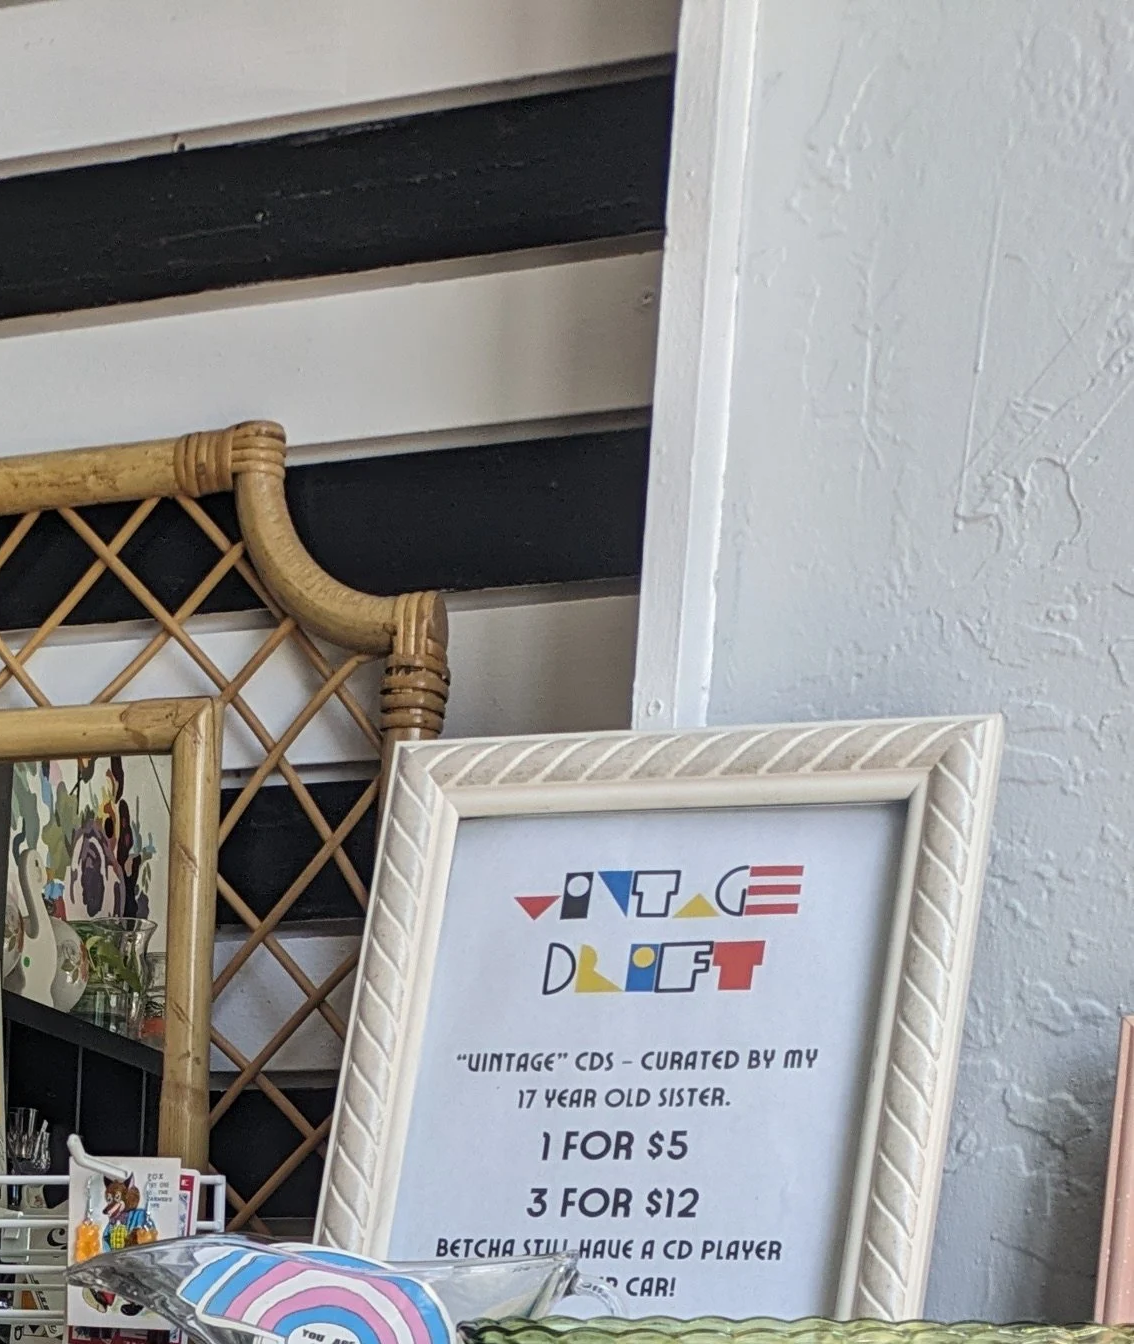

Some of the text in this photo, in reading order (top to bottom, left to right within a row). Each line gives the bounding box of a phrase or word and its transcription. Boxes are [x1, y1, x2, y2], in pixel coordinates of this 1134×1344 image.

[513, 865, 804, 921] VINTAGE
[542, 940, 766, 996] DRIFT
[574, 1051, 614, 1072] CDS
[640, 1050, 740, 1071] CURATED
[746, 1048, 776, 1070] BY
[782, 1048, 819, 1069] MY
[517, 1087, 731, 1109] 17 YEAR OLD SISTER.
[540, 1130, 689, 1161] 1 FOR $5
[526, 1187, 699, 1218] 3 FOR $12
[435, 1238, 516, 1258] BETCHA
[640, 1239, 655, 1260] A
[662, 1239, 694, 1260] CD
[700, 1240, 783, 1261] PLAYER
[625, 1276, 679, 1298] CAR!
[301, 1329, 326, 1343] YOU
